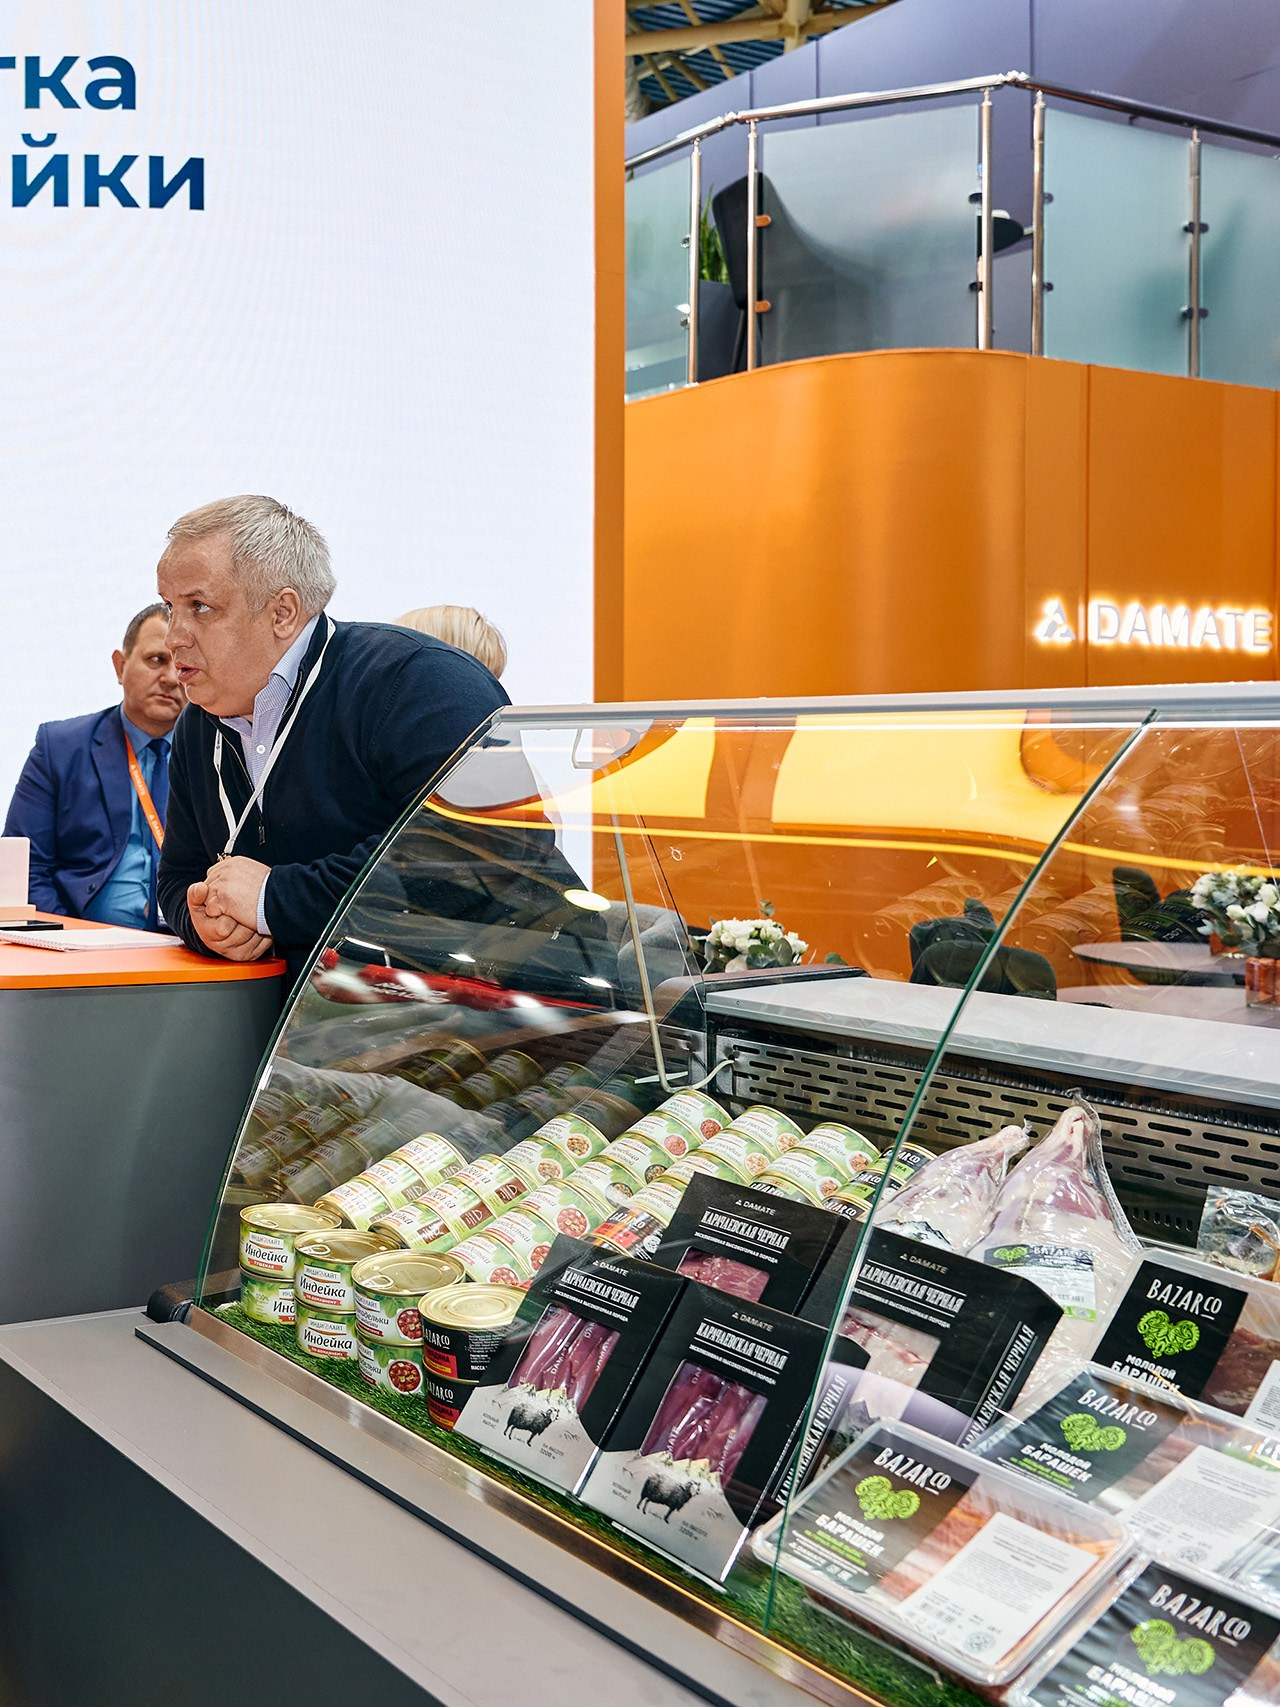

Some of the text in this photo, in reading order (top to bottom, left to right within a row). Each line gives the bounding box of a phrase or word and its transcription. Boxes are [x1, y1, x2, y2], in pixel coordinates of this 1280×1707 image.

[1089, 601, 1272, 650] DAMATE
[742, 1200, 777, 1216] DAMATE
[701, 1211, 790, 1250] КАРАЧАЕВСКАЯ ЧЕРНАЯ
[244, 1243, 289, 1264] Индейка
[598, 1261, 630, 1277] DAMATE
[908, 1254, 949, 1275] DAMATE
[299, 1276, 346, 1298] Индейка
[561, 1270, 640, 1309] КАРАЧАЕВСКАЯ ЧЕРНАЯ
[859, 1263, 965, 1314] КАРАЧАЕВСКАЯ ЧЕРНАЯ
[1146, 1278, 1223, 1320] BAZARCO
[304, 1329, 353, 1349] Индейка
[740, 1314, 775, 1332] DAMATE
[696, 1322, 788, 1370] КАРАЧАЕВСКАЯ ЧЕРНАЯ
[962, 1323, 1037, 1450] АРАЧАЕВСКАЯ ЧЕРНАЯ
[1125, 1354, 1177, 1381] МОЛОДОЙ
[816, 1374, 848, 1420] ЧЕРНАЯ
[1077, 1388, 1158, 1428] BAZARCO
[873, 1447, 952, 1491] BAZARCO
[1020, 1444, 1094, 1482] БАРАШЕК
[1039, 1442, 1092, 1471] МОЛОДОЙ
[814, 1514, 886, 1558] БАРАШЕК
[1149, 1584, 1252, 1641] BAZARCO
[1086, 1664, 1170, 1707] БАРАШ
